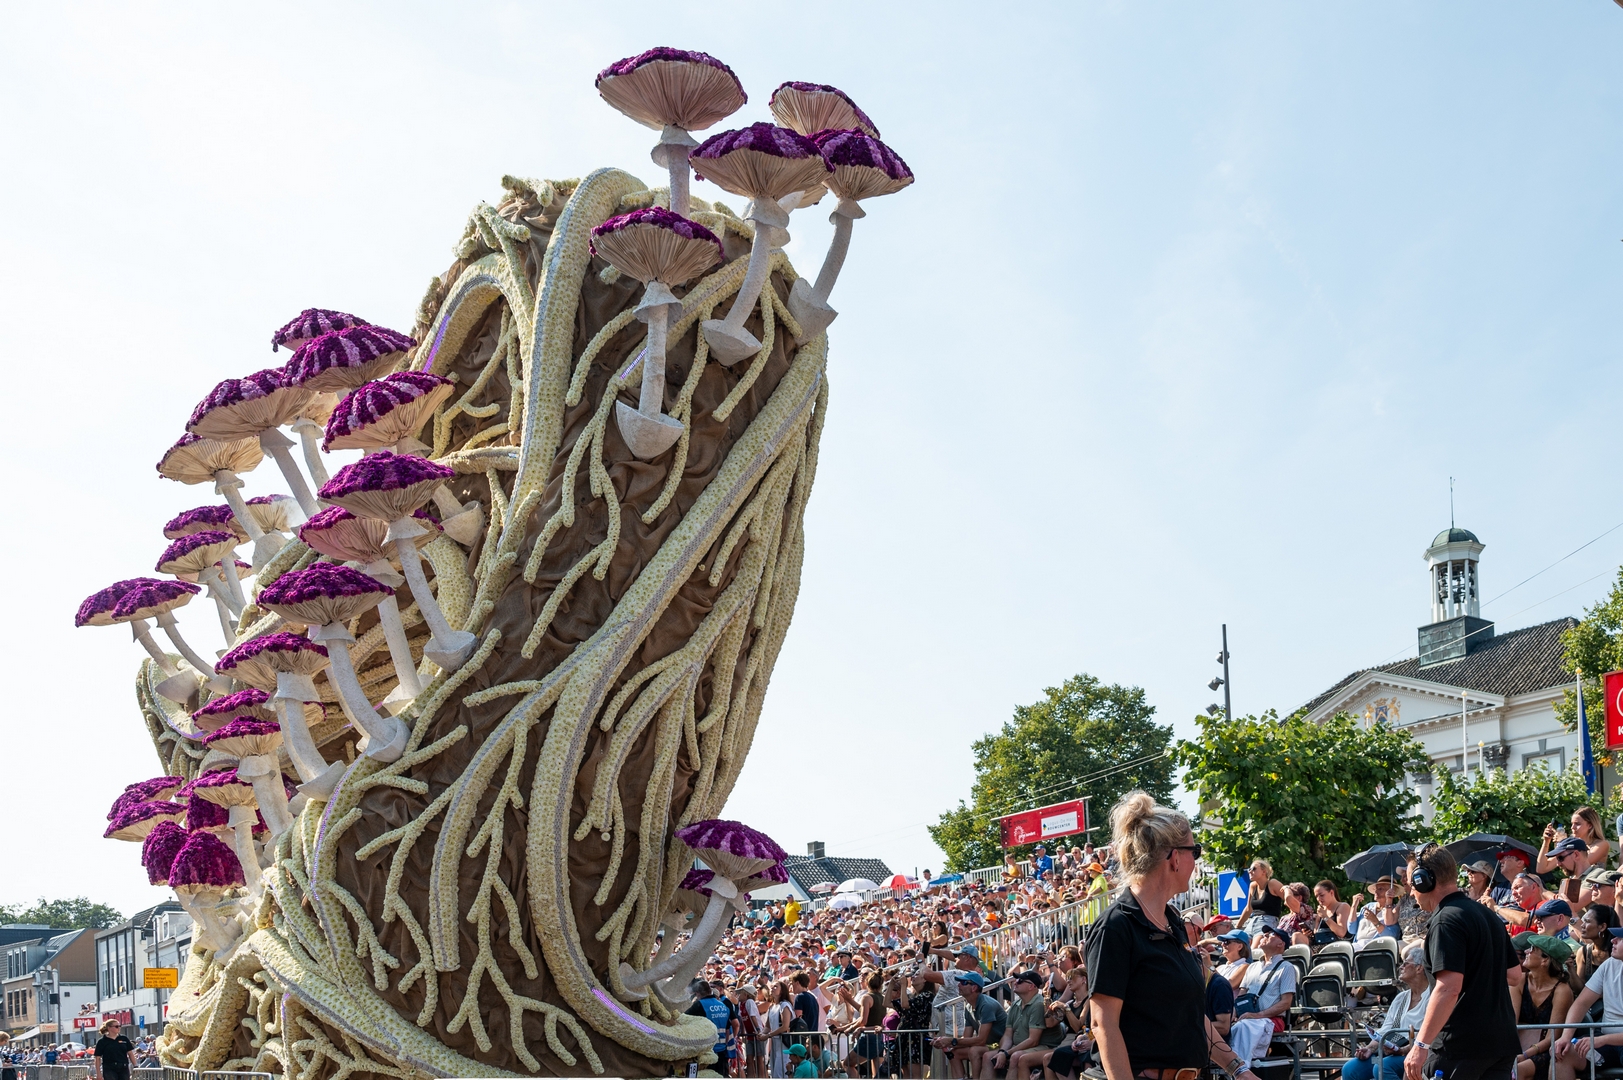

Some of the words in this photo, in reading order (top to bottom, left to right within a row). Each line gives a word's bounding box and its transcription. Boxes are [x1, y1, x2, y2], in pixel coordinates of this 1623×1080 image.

[1008, 819, 1012, 828] E
[77, 1018, 92, 1027] Dirk
[690, 1065, 696, 1075] 18
